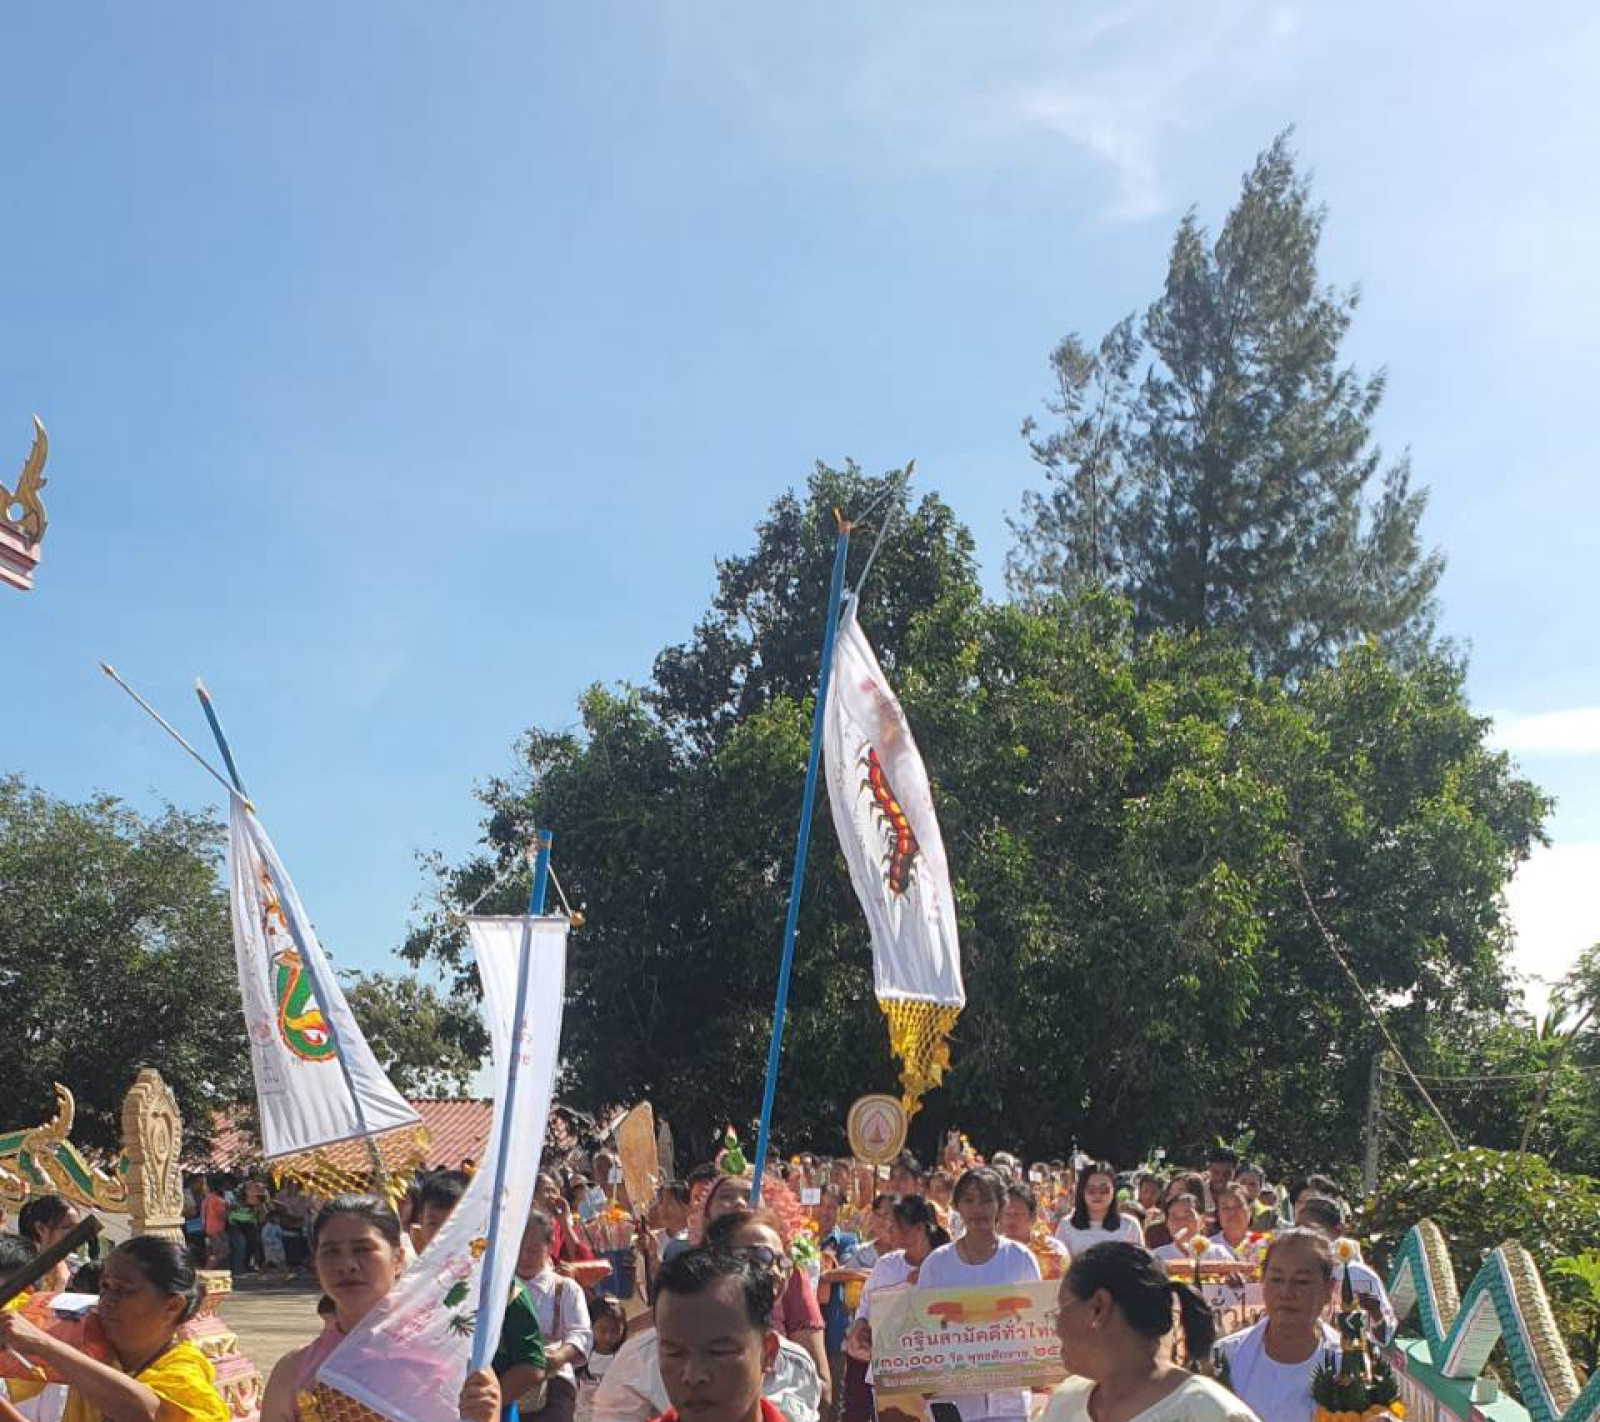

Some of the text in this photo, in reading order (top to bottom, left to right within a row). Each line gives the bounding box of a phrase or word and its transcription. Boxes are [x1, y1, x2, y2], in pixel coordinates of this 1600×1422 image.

[901, 1319, 1055, 1351] กฐินสามัคคีทั่วไท
[1033, 1344, 1060, 1357] ๒๕
